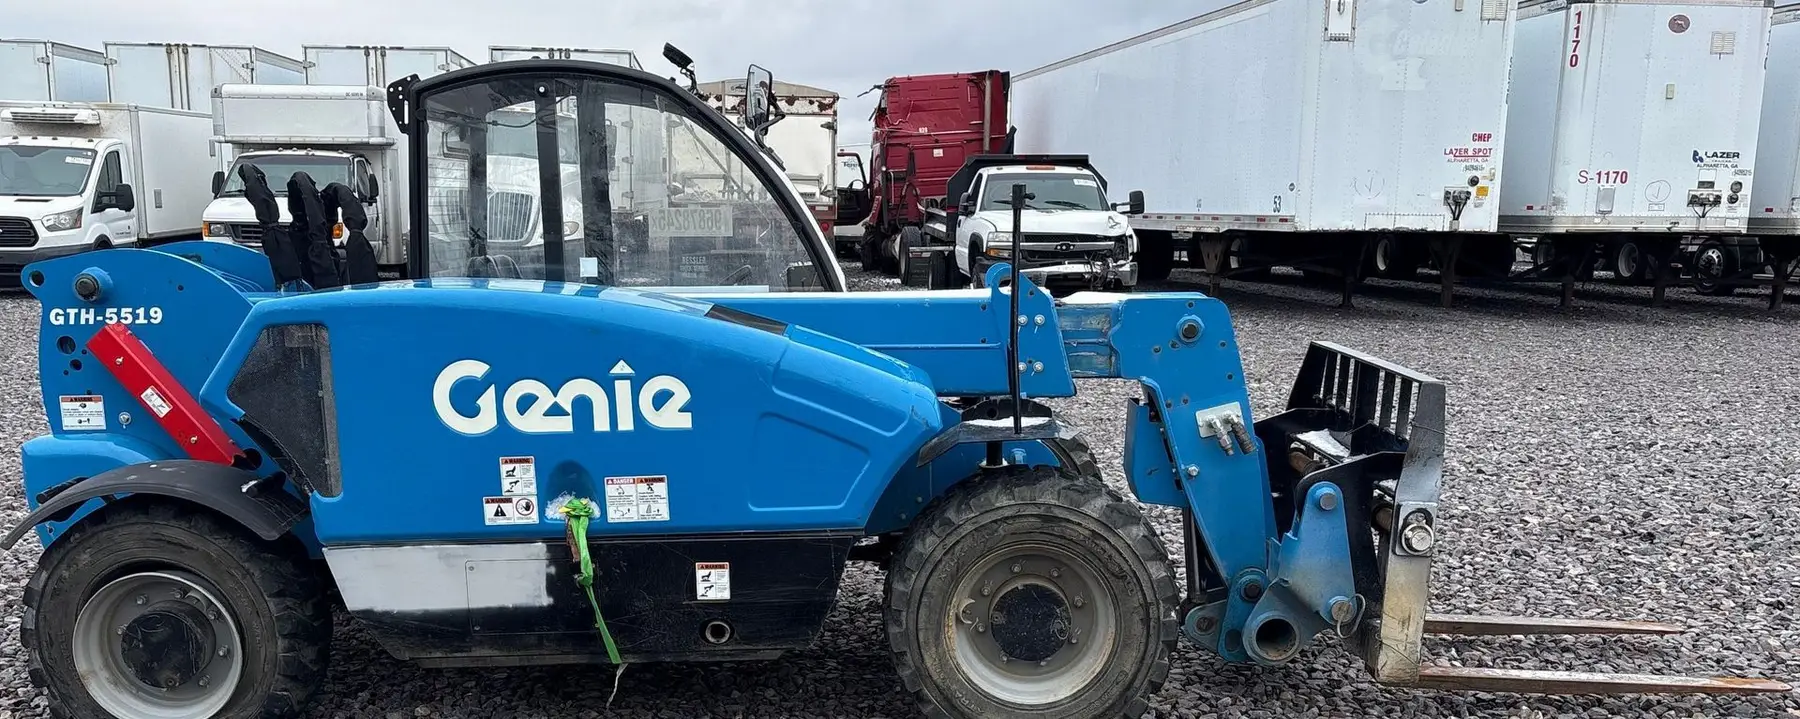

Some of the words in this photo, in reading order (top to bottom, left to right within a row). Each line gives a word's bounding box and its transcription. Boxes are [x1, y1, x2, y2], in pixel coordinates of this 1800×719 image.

[1570, 10, 1582, 68] 1170
[1472, 133, 1492, 142] CHEP
[1444, 148, 1469, 157] LAZER
[1704, 151, 1741, 159] LAZER
[1577, 170, 1629, 185] S-1170
[1272, 195, 1282, 213] 53
[49, 307, 163, 326] GTH-5519
[432, 359, 693, 435] Genie
